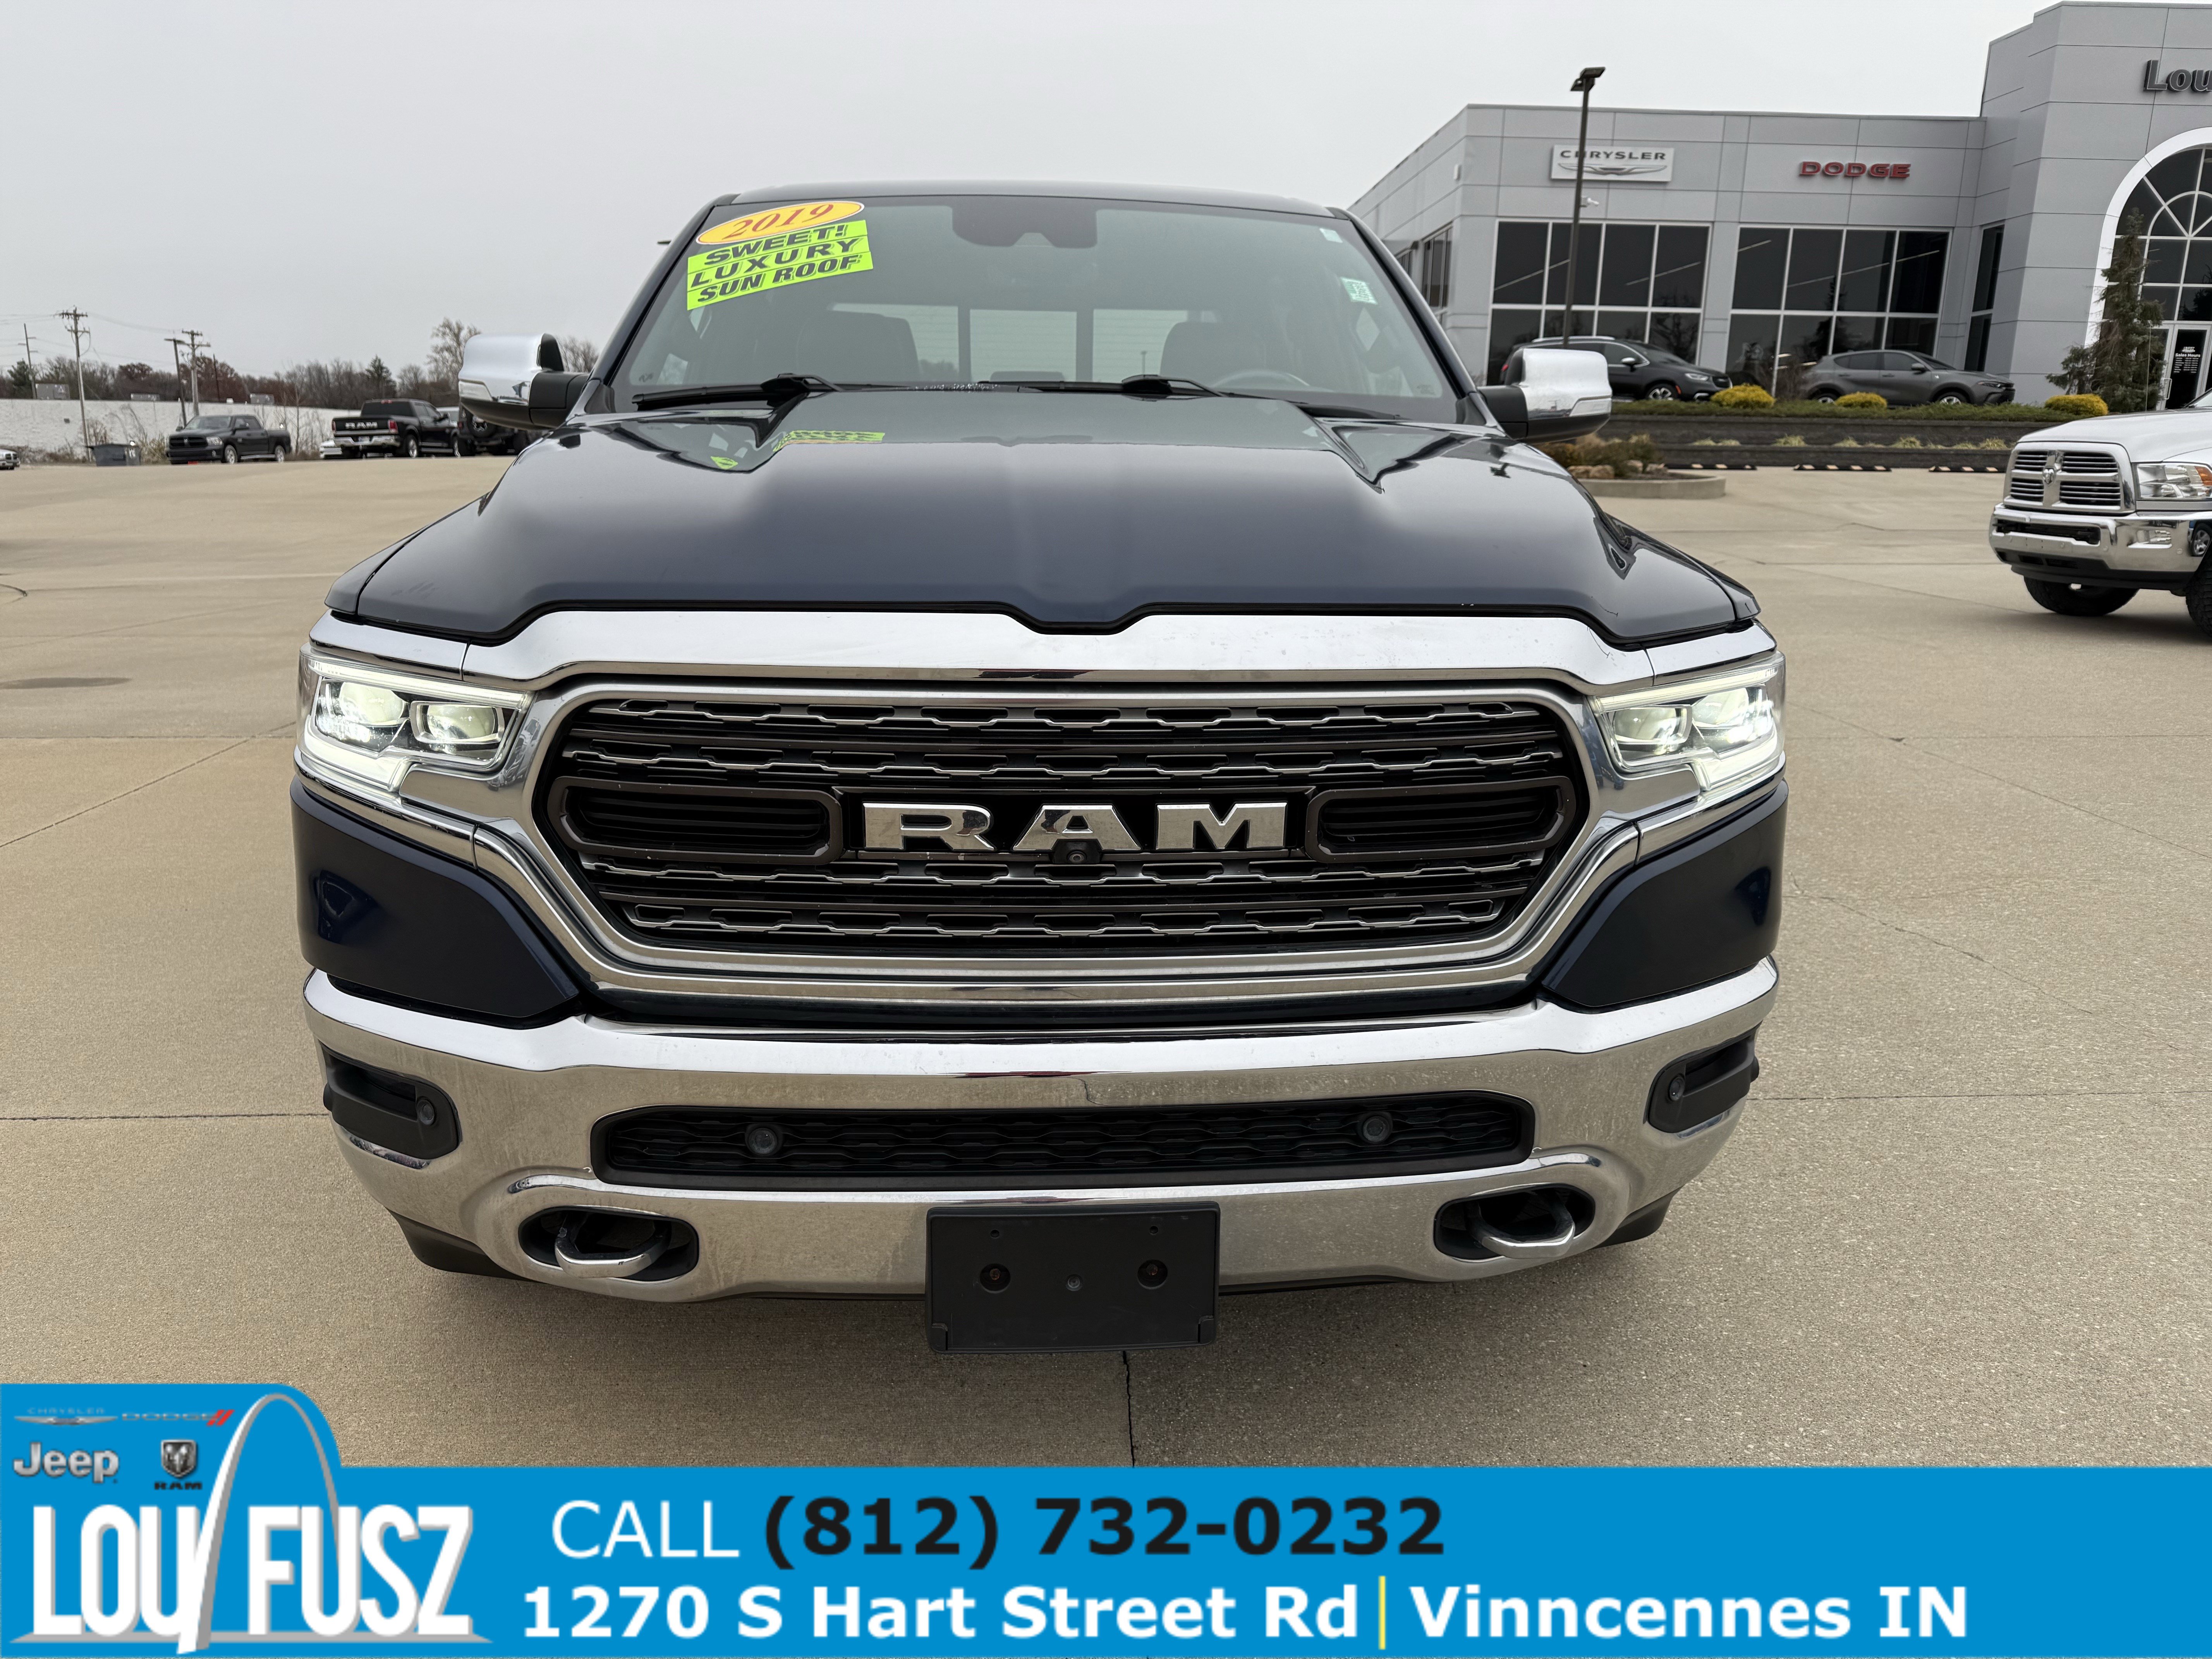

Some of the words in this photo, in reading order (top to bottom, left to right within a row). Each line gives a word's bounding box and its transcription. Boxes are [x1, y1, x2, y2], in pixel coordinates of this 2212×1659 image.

[2144, 60, 2212, 93] Lou
[1800, 161, 1911, 178] DODGE
[721, 204, 834, 240] 2019
[690, 238, 864, 288] LUXURY
[704, 225, 848, 265] SWEET!
[697, 273, 766, 302] SUN
[772, 254, 862, 283] ROOF
[862, 802, 1288, 851] RAM
